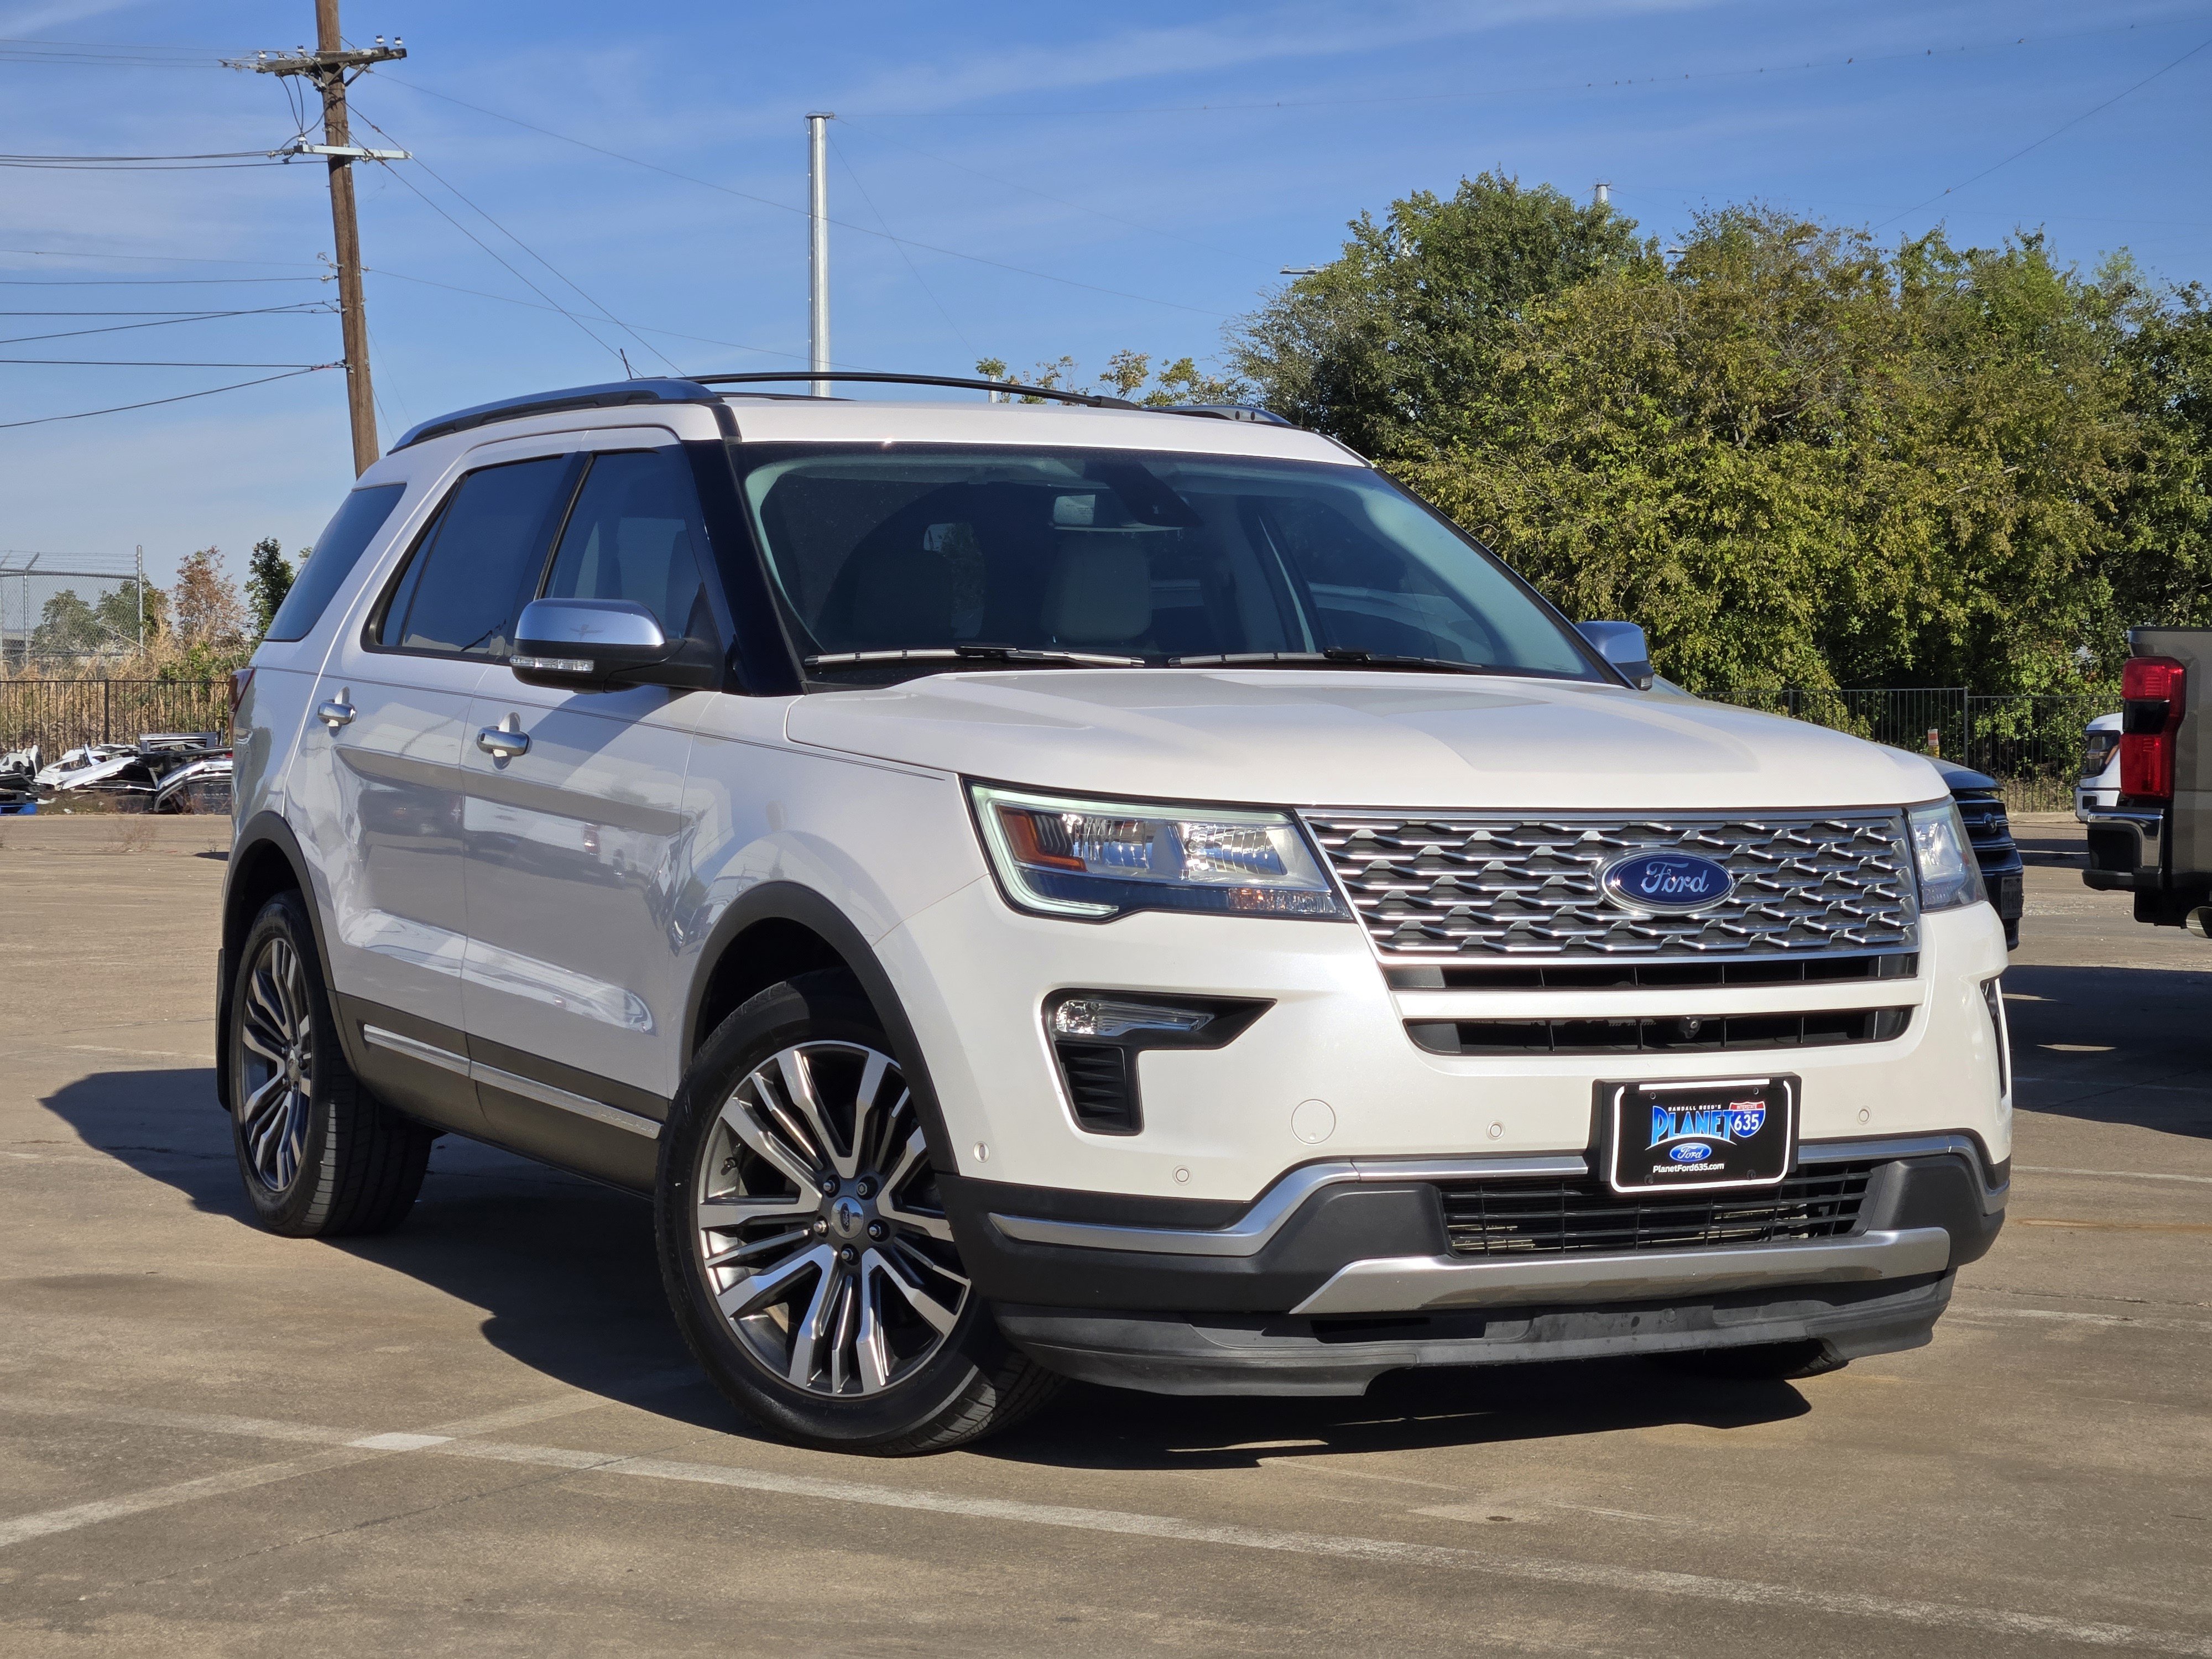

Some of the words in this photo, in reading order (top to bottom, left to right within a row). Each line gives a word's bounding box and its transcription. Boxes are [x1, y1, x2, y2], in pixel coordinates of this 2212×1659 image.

[1641, 861, 1709, 893] Ford
[1651, 1105, 1734, 1146] PLANET
[1734, 1114, 1759, 1131] 635
[1677, 1146, 1704, 1159] Ford
[1653, 1163, 1724, 1173] PlanetFord635.com
